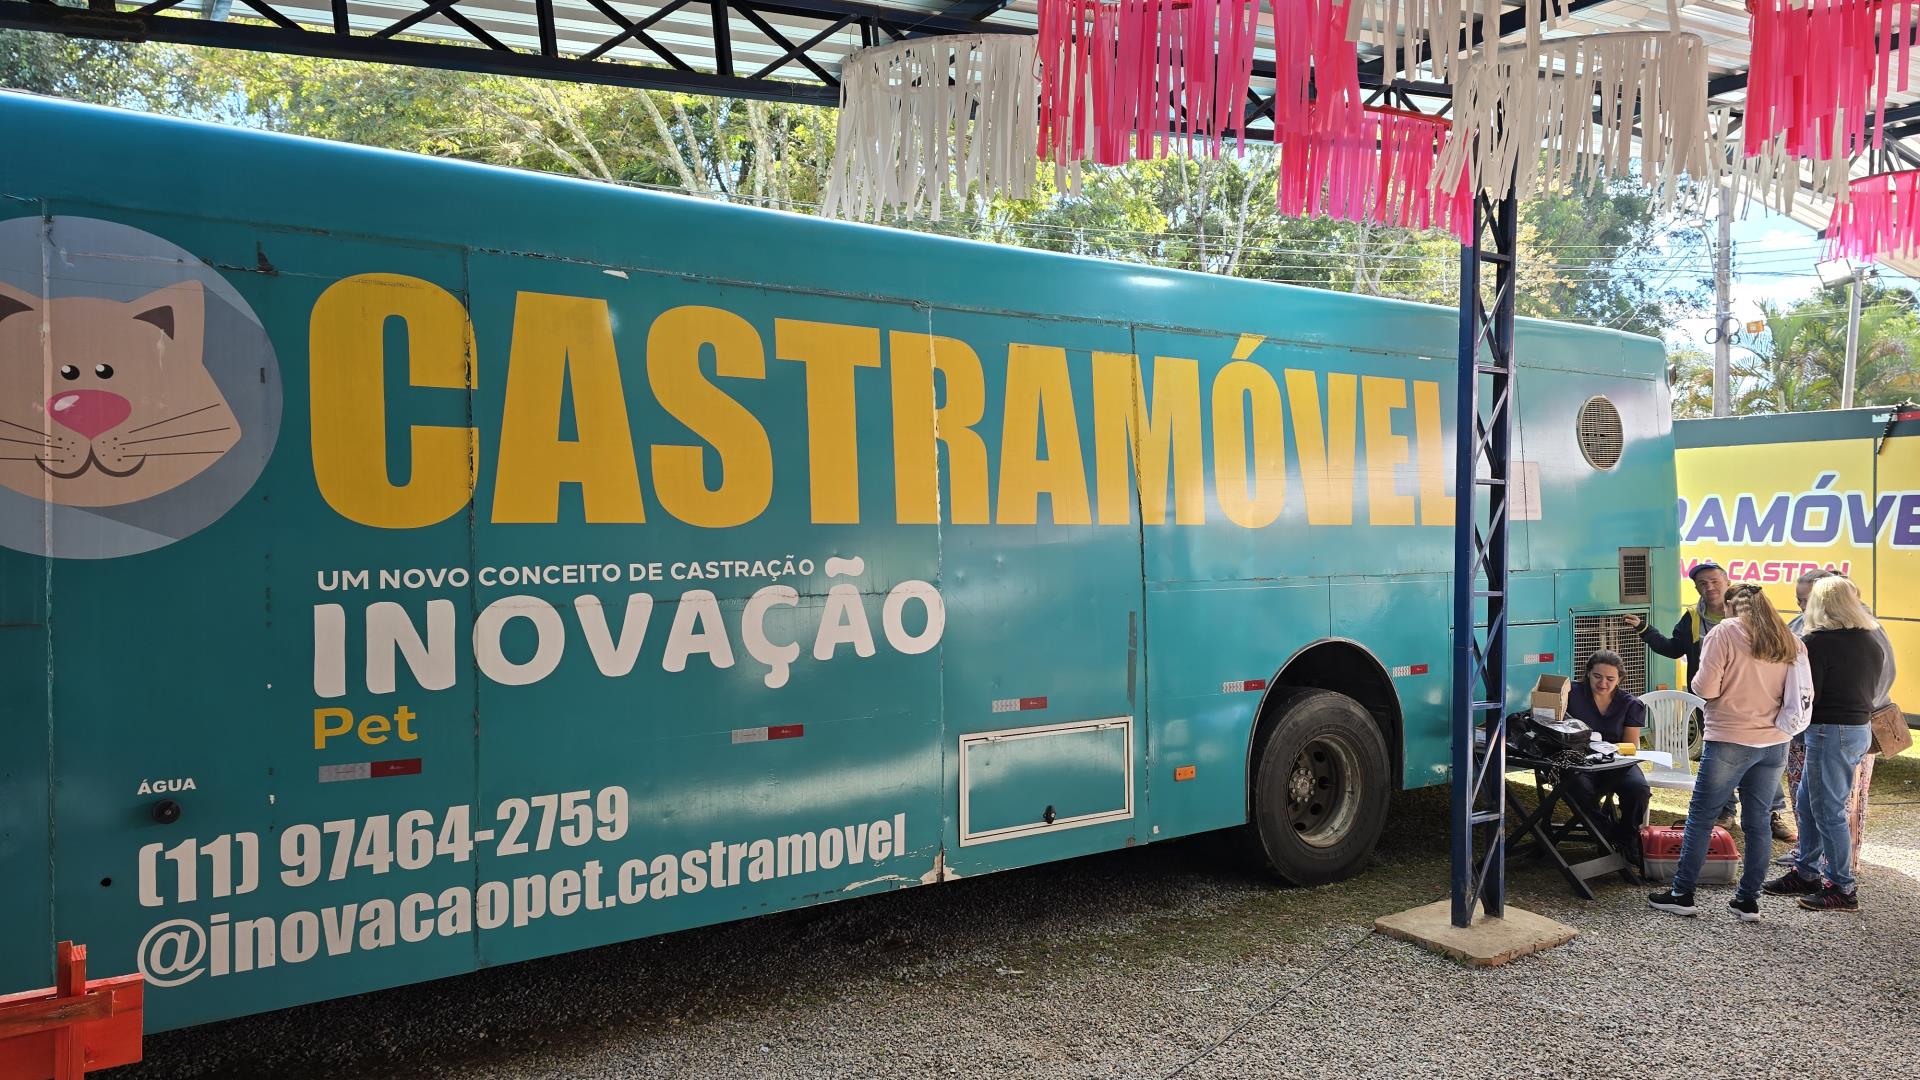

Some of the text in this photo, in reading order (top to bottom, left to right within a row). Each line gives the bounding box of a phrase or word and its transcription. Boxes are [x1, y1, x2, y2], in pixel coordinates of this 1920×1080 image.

[309, 272, 1456, 530] CASTRAMÓVEL
[1679, 474, 1920, 546] AMÓVE
[318, 555, 815, 591] UM NOVO CONCEITO DE CASTRAÇÃO
[313, 556, 945, 698] INOVAÇÃO
[313, 705, 419, 750] Pet
[137, 778, 197, 795] ÁGUA
[138, 786, 629, 907] (11) 97464-2759
[137, 813, 905, 988] @inovacaopet.castramovel
